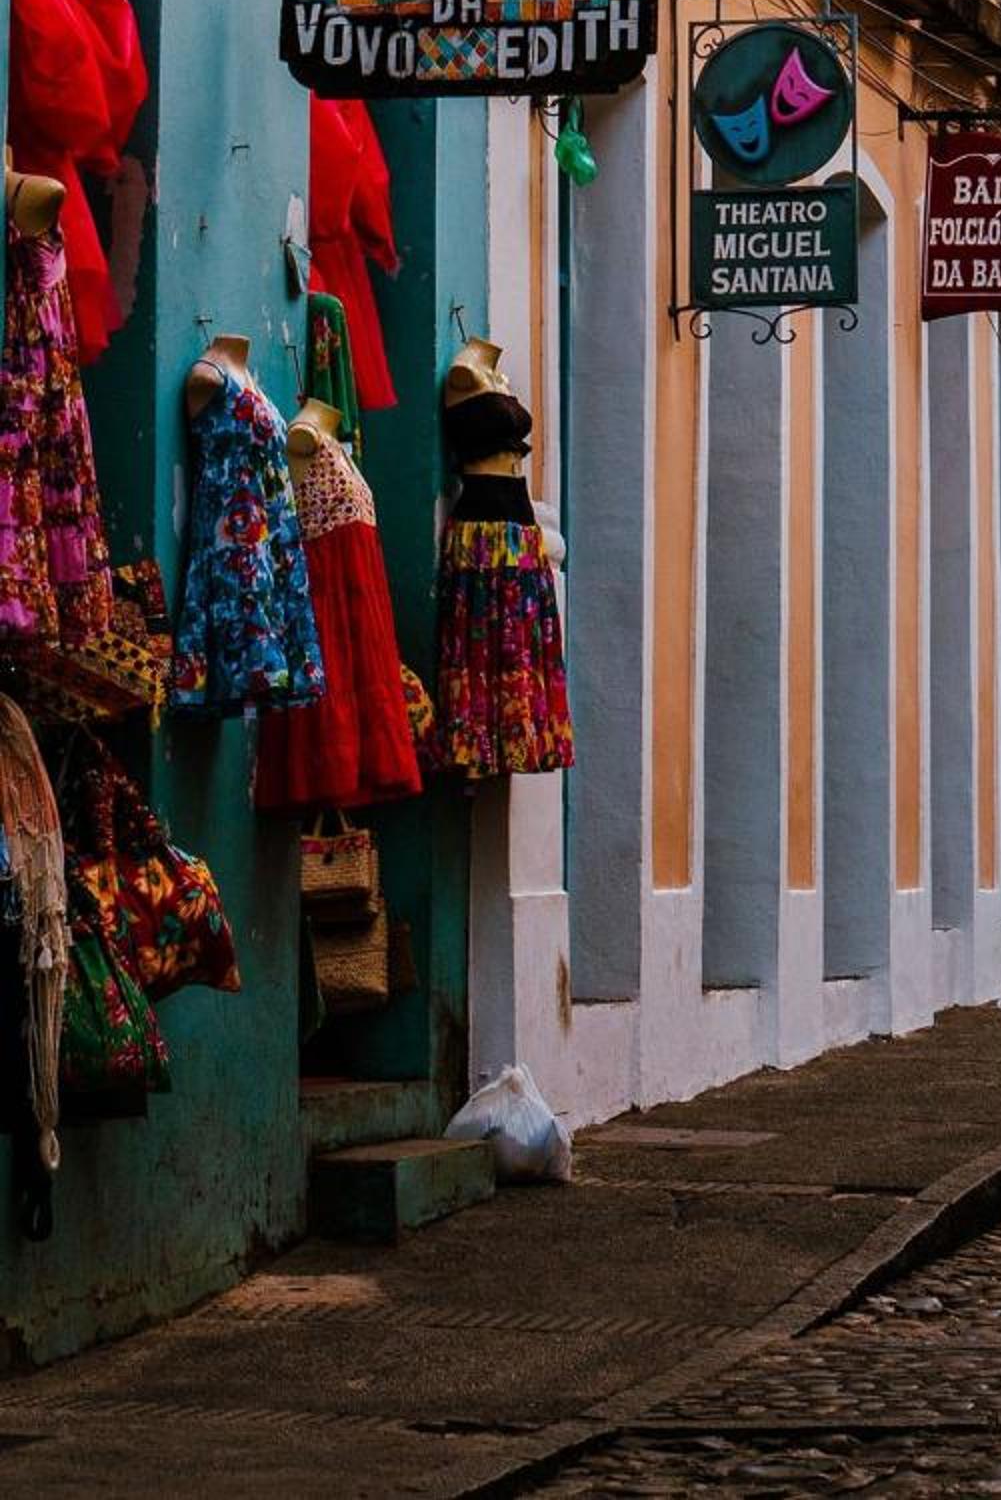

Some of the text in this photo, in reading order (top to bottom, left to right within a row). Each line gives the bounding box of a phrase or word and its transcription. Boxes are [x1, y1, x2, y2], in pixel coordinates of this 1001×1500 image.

[498, 0, 640, 79] EDITH
[715, 201, 828, 225] THEATRO
[713, 230, 831, 260] MIGUEL
[711, 264, 835, 295] SANTANA
[931, 259, 965, 288] DA
